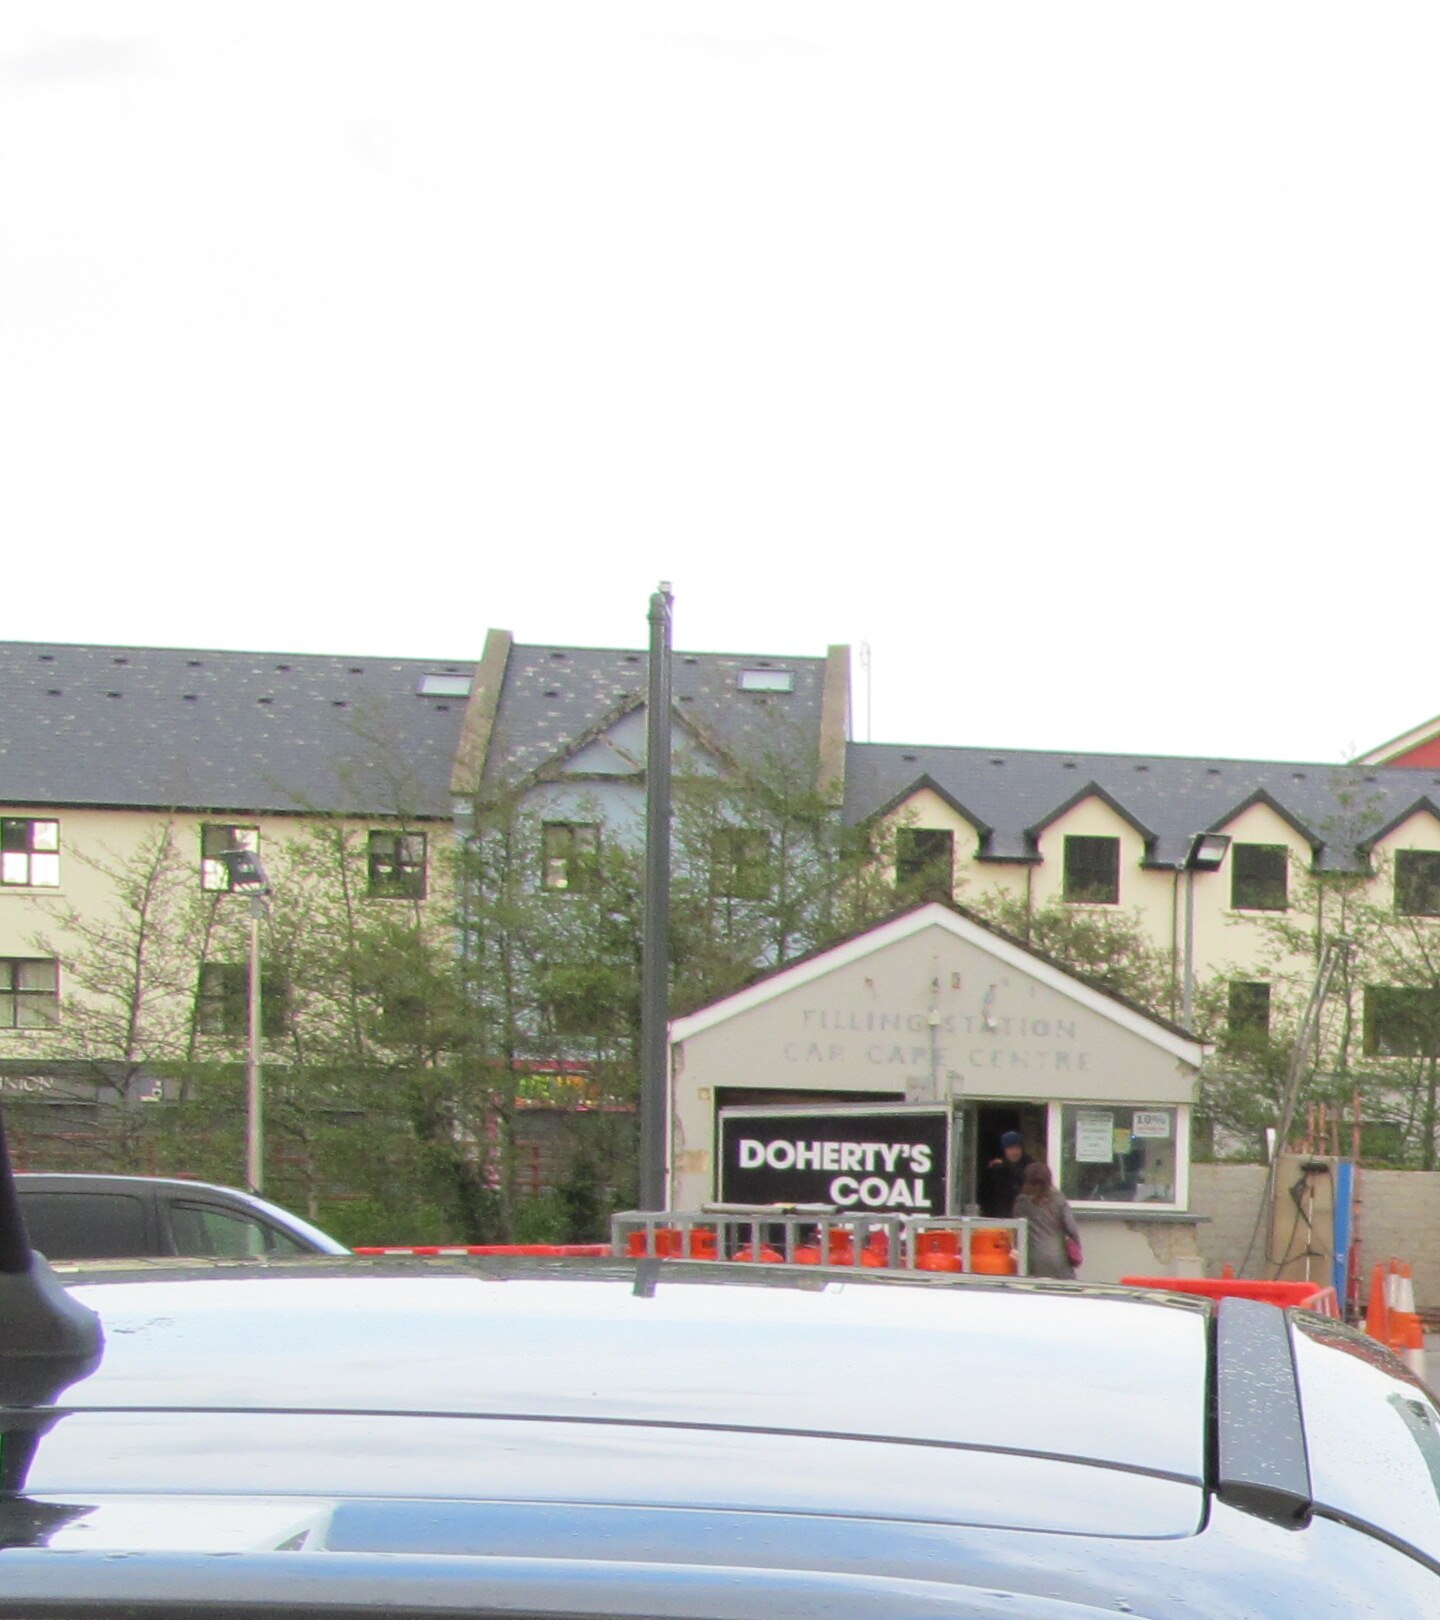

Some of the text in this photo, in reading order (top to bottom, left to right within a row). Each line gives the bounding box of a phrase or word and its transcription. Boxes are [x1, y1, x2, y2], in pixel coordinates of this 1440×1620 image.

[803, 1008, 1078, 1039] FILLING STATION
[783, 1043, 845, 1064] CAR
[738, 1138, 932, 1174] DOHERTY'S
[829, 1177, 932, 1208] COAL
